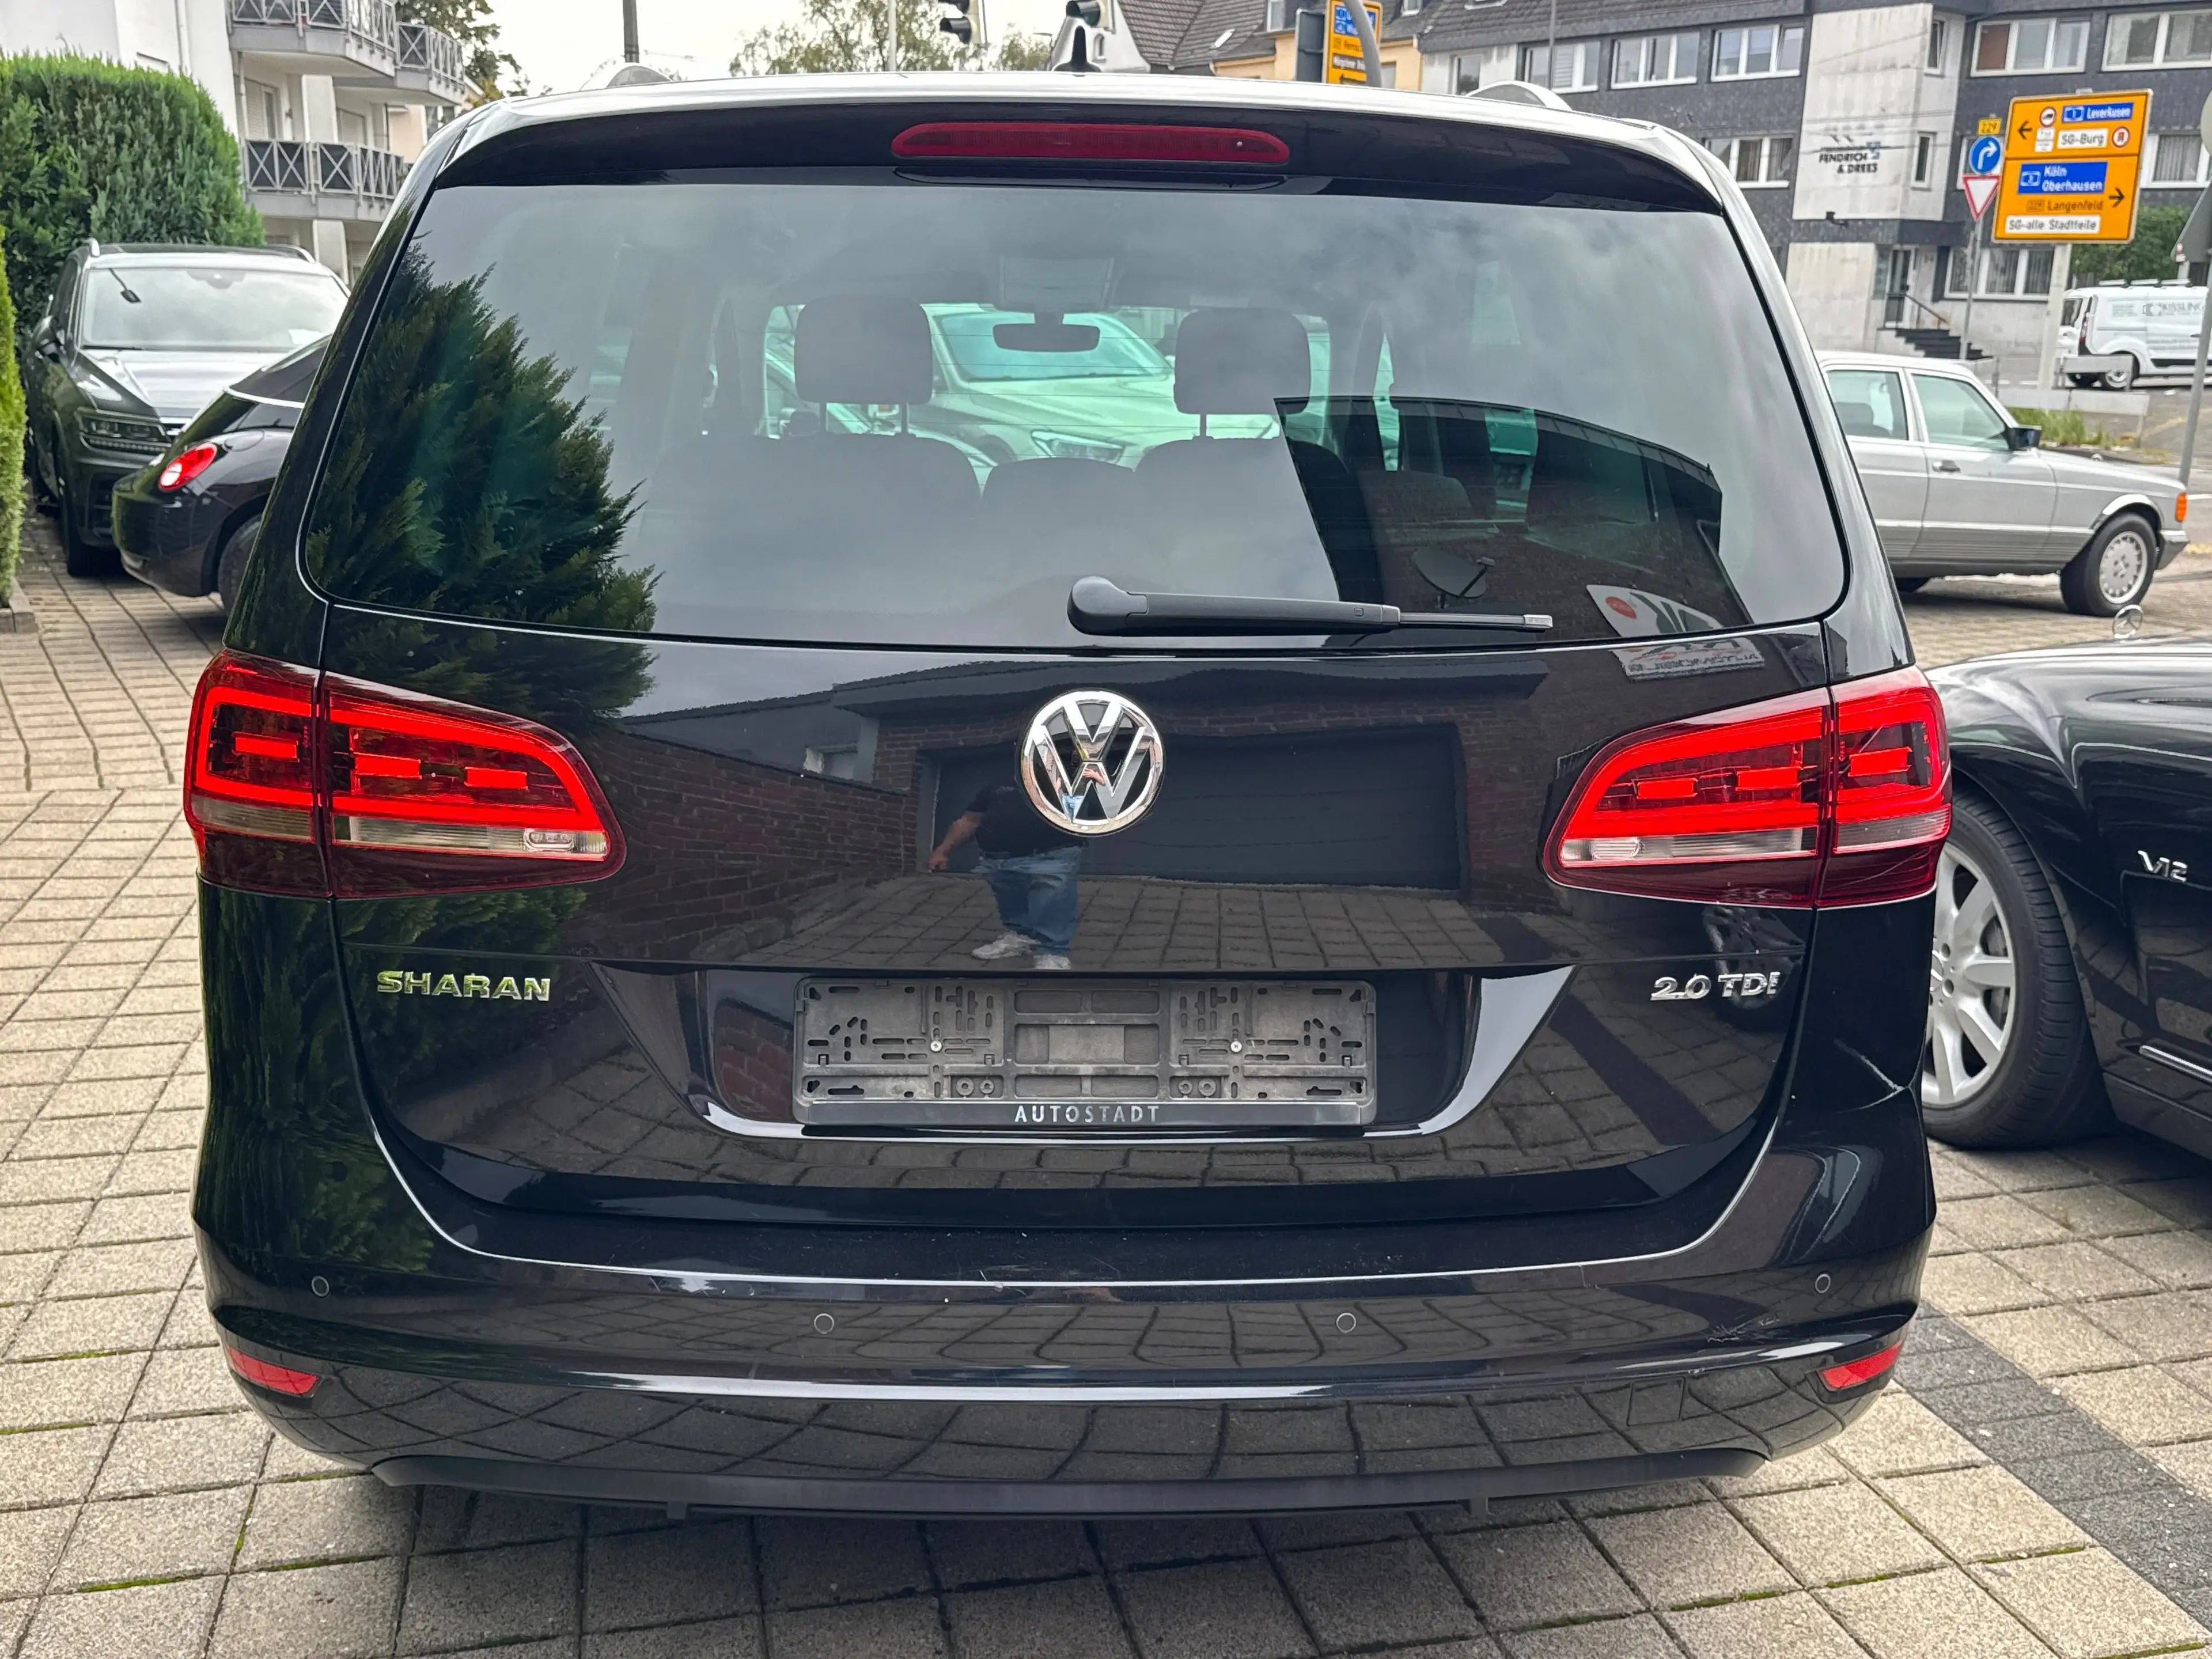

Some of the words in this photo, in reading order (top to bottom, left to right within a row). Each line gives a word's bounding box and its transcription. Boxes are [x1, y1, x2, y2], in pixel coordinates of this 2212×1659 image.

[2086, 106, 2131, 119] Leverkusen
[2061, 132, 2104, 146] SG-Burg
[2044, 165, 2067, 177] Köln
[2041, 179, 2103, 192] Oberhausen
[2047, 200, 2103, 213] Langenfeld
[2009, 219, 2044, 230] SG-alle
[2049, 218, 2097, 230] Stadtteile
[2138, 850, 2187, 882] V12
[377, 970, 551, 1002] SHARAN
[1650, 975, 1712, 1001] 2.0
[1717, 971, 1781, 998] TDI
[1014, 1105, 1160, 1123] AUTOSTADT
